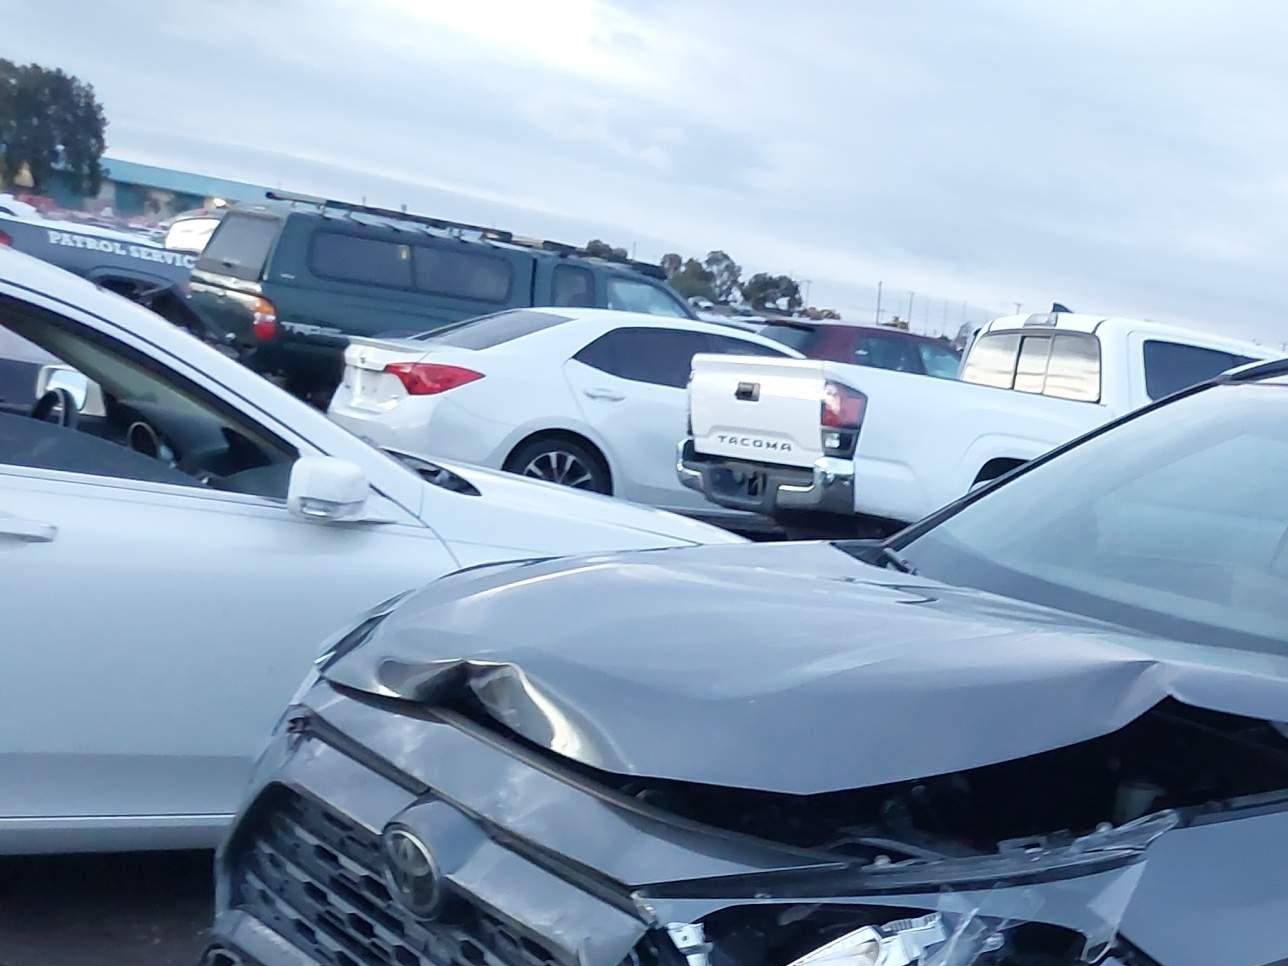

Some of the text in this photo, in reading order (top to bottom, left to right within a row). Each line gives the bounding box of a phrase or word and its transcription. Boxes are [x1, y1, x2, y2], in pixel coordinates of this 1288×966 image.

[48, 231, 196, 269] PATROL SERVIC
[717, 434, 792, 452] TACOMA
